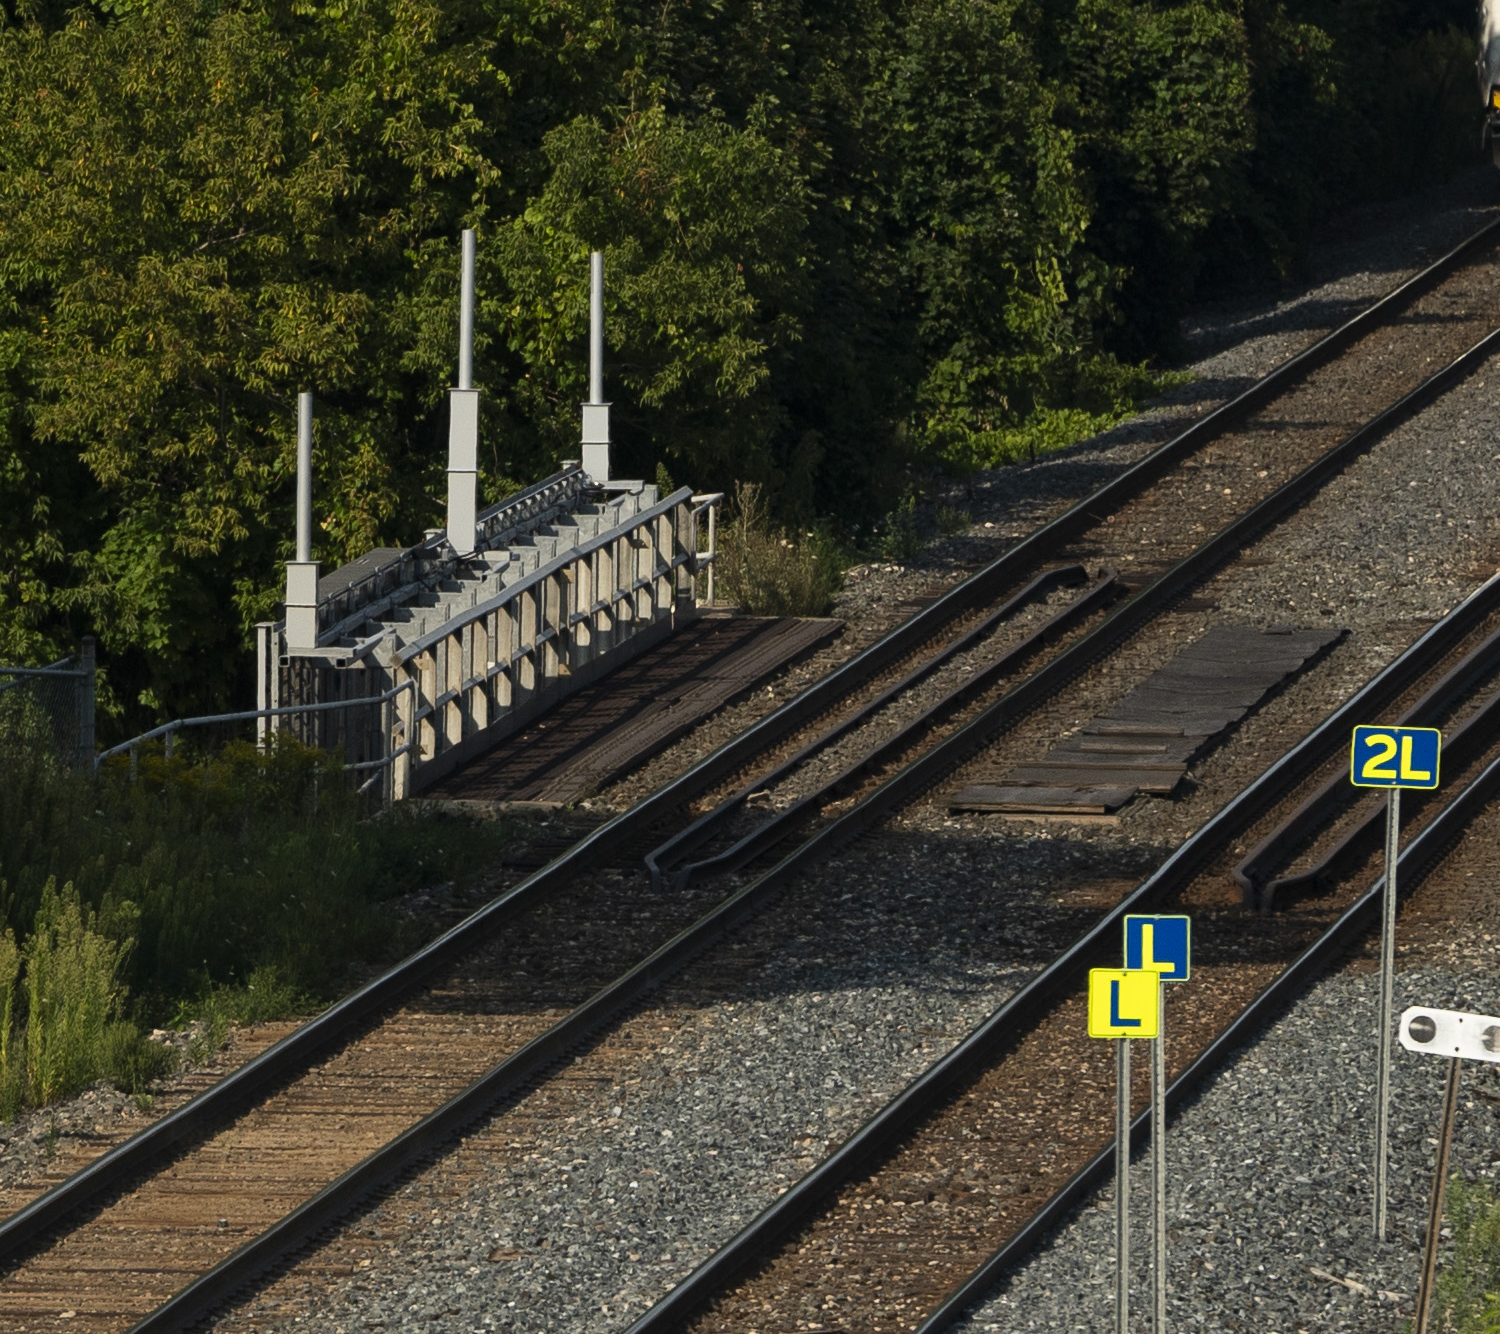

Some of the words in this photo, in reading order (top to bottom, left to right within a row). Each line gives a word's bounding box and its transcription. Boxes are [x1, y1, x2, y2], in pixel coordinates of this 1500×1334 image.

[1362, 733, 1431, 781] 2L
[1141, 923, 1175, 973] L
[1109, 979, 1142, 1028] L
